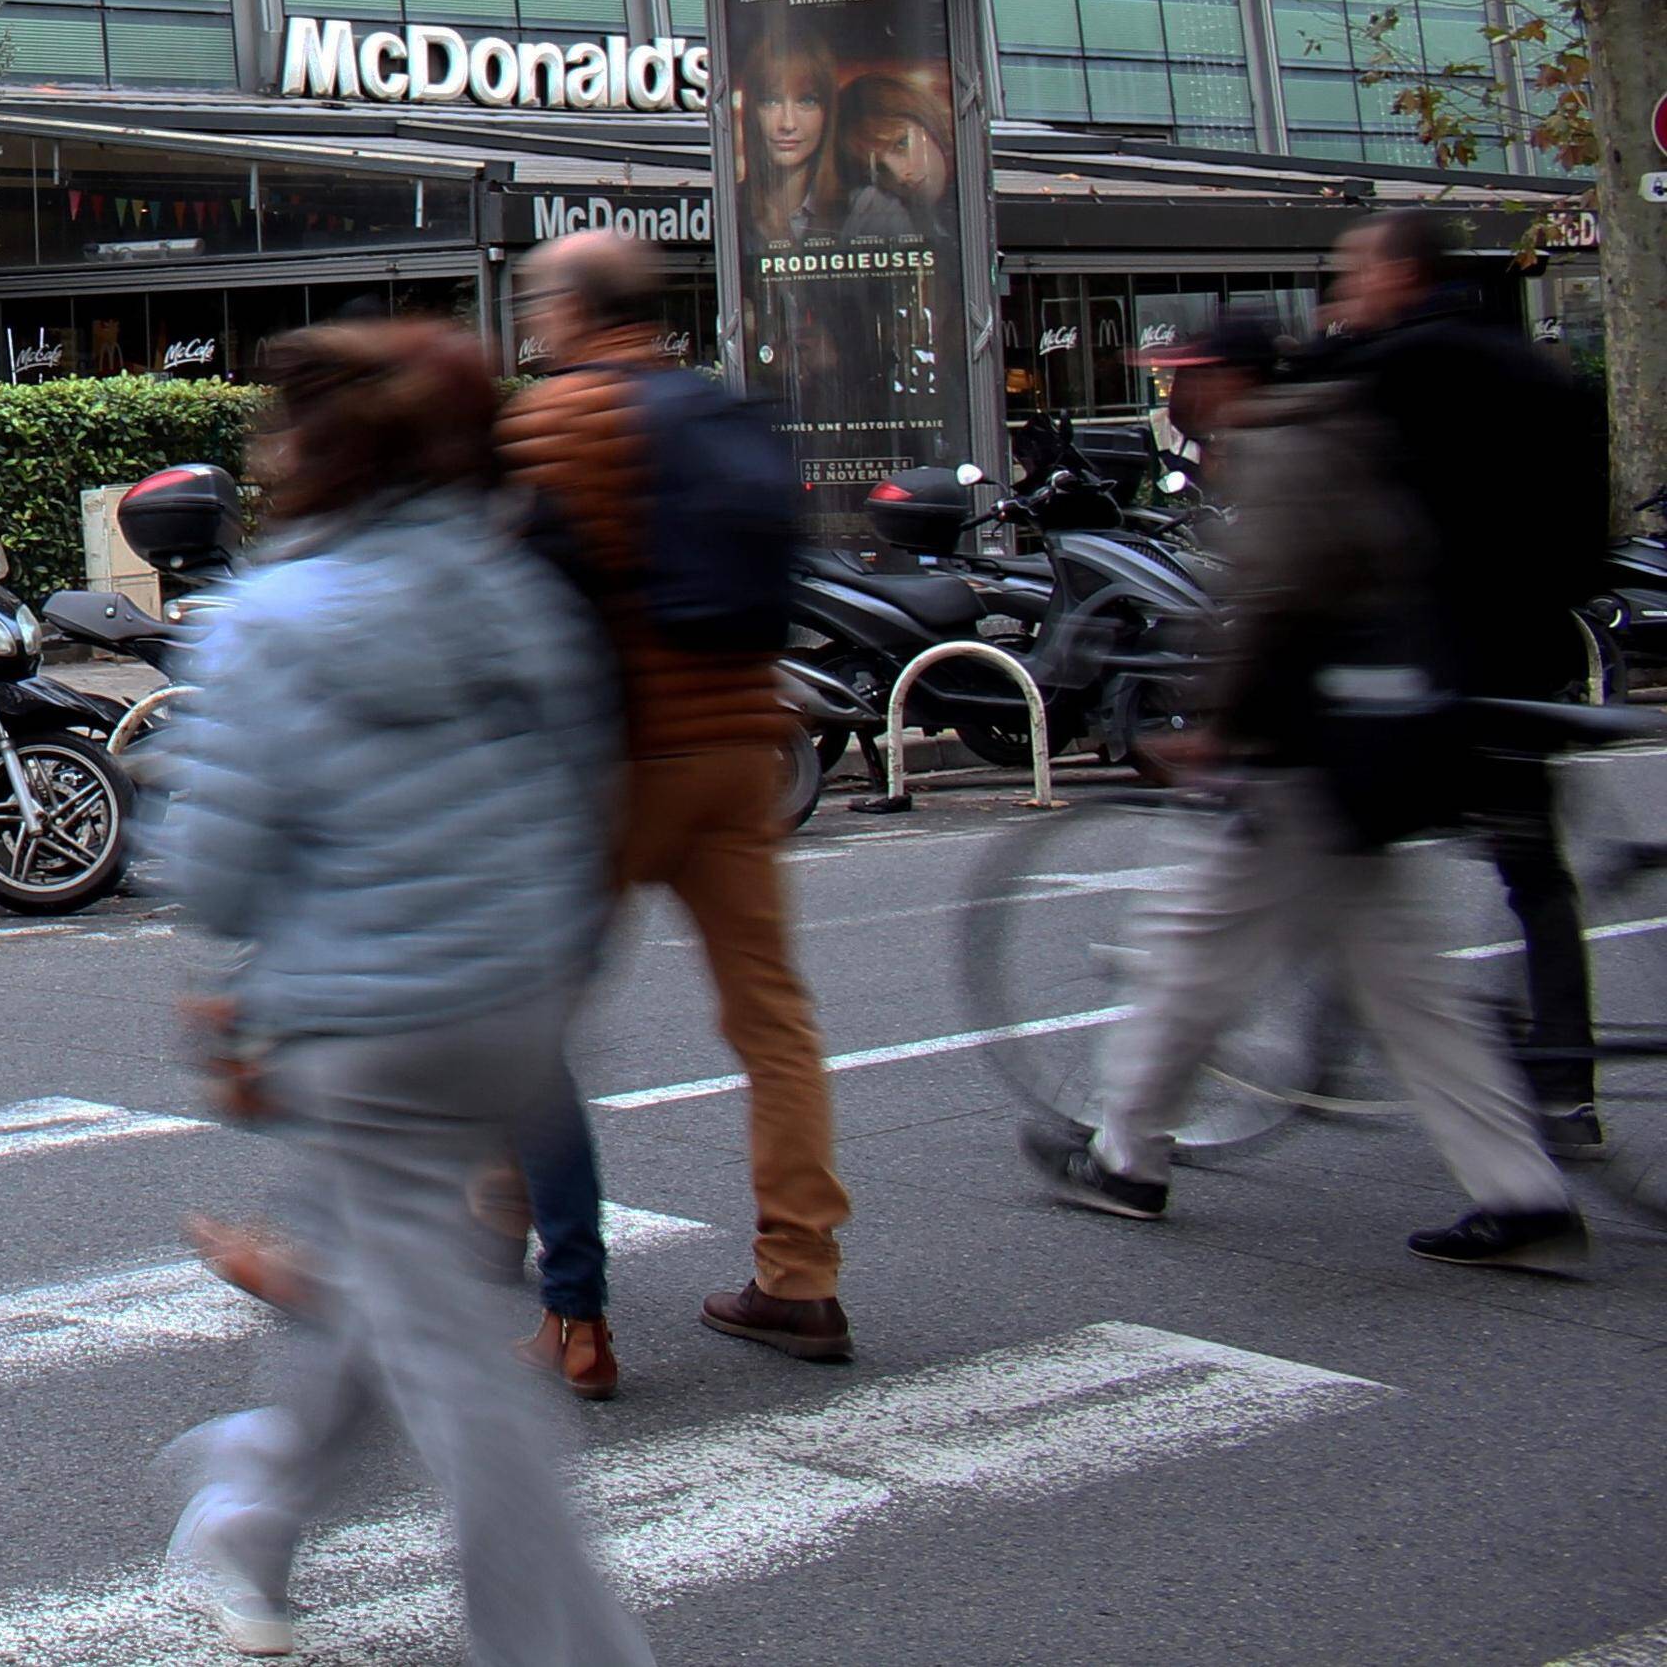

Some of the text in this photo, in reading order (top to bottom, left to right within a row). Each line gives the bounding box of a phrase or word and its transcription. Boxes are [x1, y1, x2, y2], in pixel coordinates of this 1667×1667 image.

[282, 16, 709, 112] McDonald's
[760, 250, 935, 274] PRODIGIEUSES
[817, 422, 841, 432] UNE
[846, 420, 906, 431] HISTOIRE
[909, 419, 944, 429] VRAIE
[892, 460, 909, 469] LE
